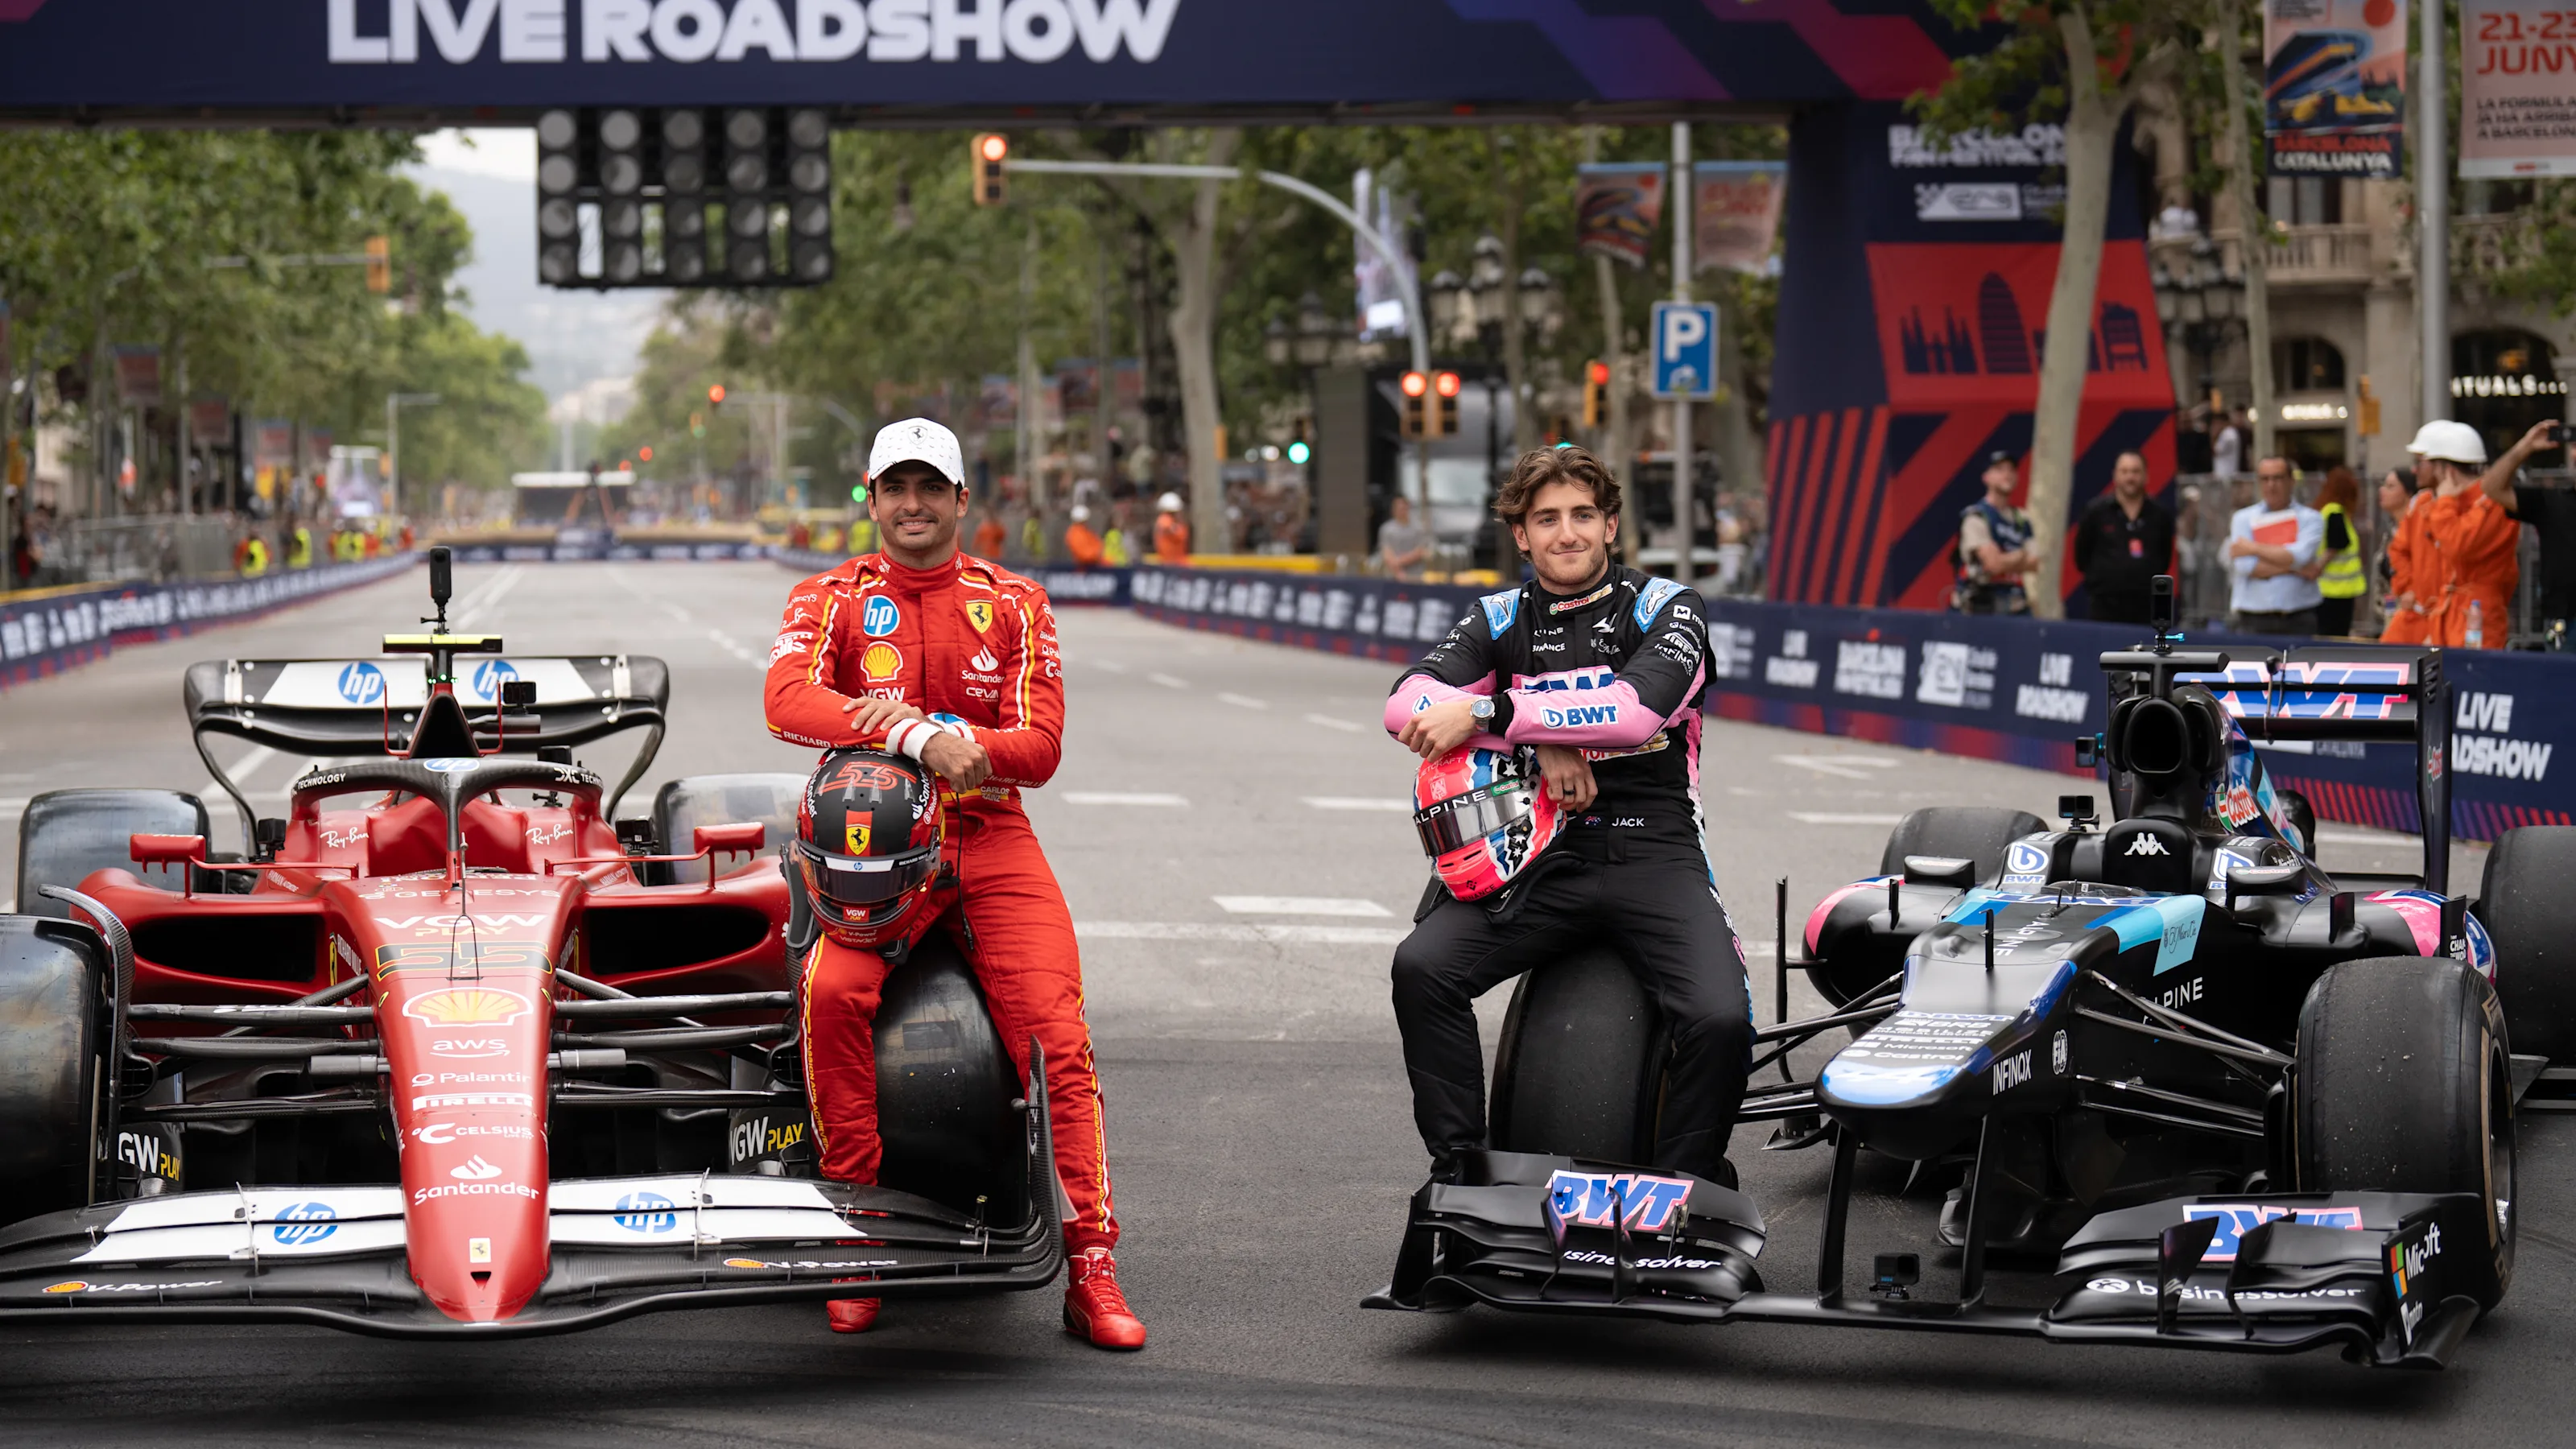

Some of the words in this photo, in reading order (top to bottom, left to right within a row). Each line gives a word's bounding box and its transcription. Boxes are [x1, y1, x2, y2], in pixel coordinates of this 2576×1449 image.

[328, 0, 567, 64] LIVE
[581, 0, 1181, 64] ROADSHOW
[2274, 135, 2391, 153] BARCELONA
[2274, 152, 2392, 172] CATALUNYA
[1663, 311, 1707, 361] P
[1558, 597, 1589, 611] Castrol
[863, 596, 898, 636] hp
[341, 661, 383, 705] hp
[475, 659, 518, 704] hp
[961, 670, 1005, 684] Santander
[2182, 662, 2409, 719] BWT
[1567, 705, 1618, 725] BWT
[2458, 691, 2514, 733] LIVE
[783, 731, 832, 749] RICHARD
[431, 759, 466, 771] hp
[2452, 733, 2553, 782] ADSHOW
[297, 773, 347, 791] TECHNOLOGY
[554, 767, 580, 784] DXC
[581, 773, 605, 789] TECHNO
[1500, 781, 1519, 791] Castrol
[980, 786, 1010, 795] CARLOS
[1414, 790, 1487, 826] ALPINE
[2226, 778, 2261, 828] Castrol
[1612, 817, 1645, 828] JACK
[320, 827, 369, 849] Ray-Ban
[525, 824, 574, 845] Ray-Ban
[2003, 874, 2046, 884] BWT
[373, 914, 548, 929] VGW
[846, 909, 866, 917] VGW
[415, 927, 512, 937] PLAY
[1992, 920, 2050, 957] ALPINE
[375, 941, 553, 982] 55
[2155, 976, 2203, 1010] PINE
[1930, 1013, 2015, 1022] BWT
[431, 1038, 506, 1051] aws
[1884, 1043, 1973, 1051] Microsoft
[2054, 1042, 2067, 1065] FIA
[1873, 1052, 1964, 1061] Castrol
[440, 1071, 531, 1084] Palantir
[1992, 1049, 2032, 1096] INFINOX
[412, 1092, 534, 1111] PIRELLI
[456, 1125, 532, 1137] CELSIUS
[730, 1116, 769, 1166] VGW
[767, 1122, 804, 1152] PLAY
[160, 1153, 181, 1182] PLAY
[414, 1182, 539, 1206] Santander
[1549, 1173, 1690, 1228] BWT
[621, 1192, 668, 1233] hp
[277, 1203, 332, 1245] hp
[86, 1280, 223, 1293] V-Power
